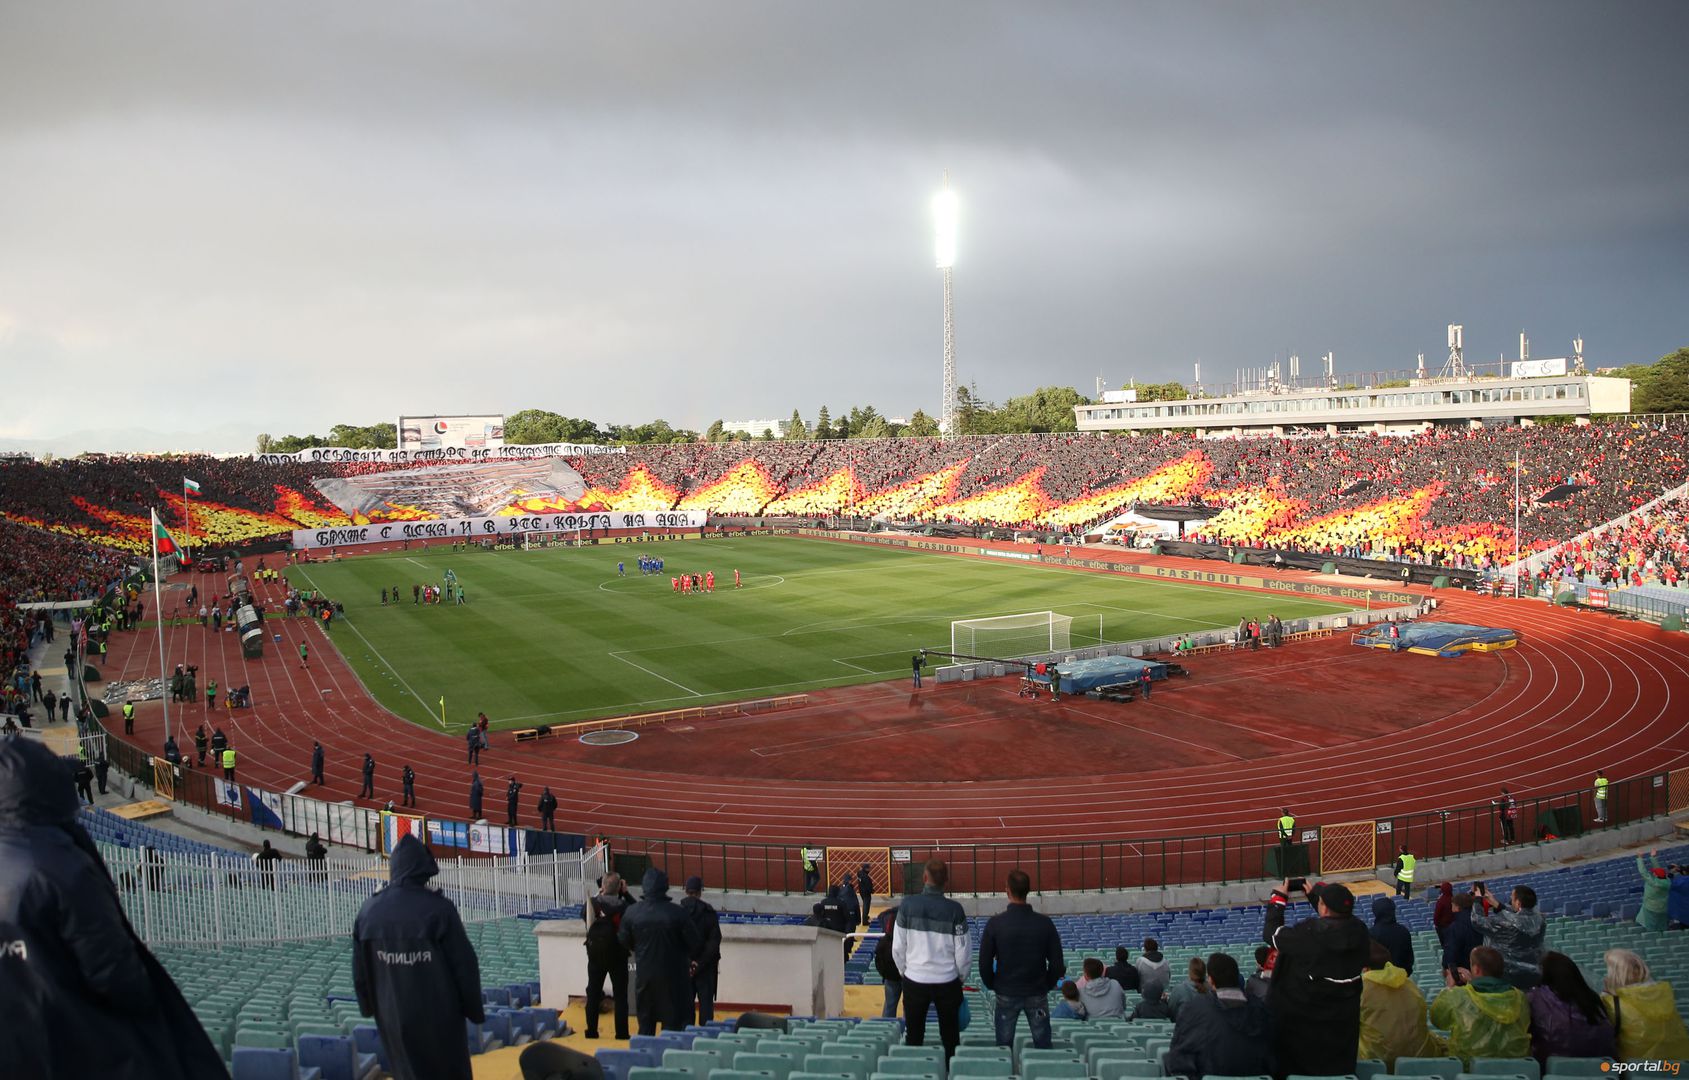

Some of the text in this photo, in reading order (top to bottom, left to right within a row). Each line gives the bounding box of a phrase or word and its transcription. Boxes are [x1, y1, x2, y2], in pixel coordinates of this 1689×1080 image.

[389, 451, 408, 463] НА
[380, 526, 393, 539] С
[460, 521, 472, 534] И
[483, 520, 496, 533] В
[623, 514, 645, 527] НА
[615, 534, 685, 543] CASHOUT
[705, 531, 724, 539] efbet
[729, 530, 746, 538] efbet
[917, 541, 967, 553] CASHOUT
[1044, 555, 1134, 573] efbet efbet efbet efbet
[1156, 567, 1242, 584] CASHOUT
[1269, 580, 1413, 604] efbet efbet efbet efbet
[377, 950, 432, 965] ПЛИЦИЯ
